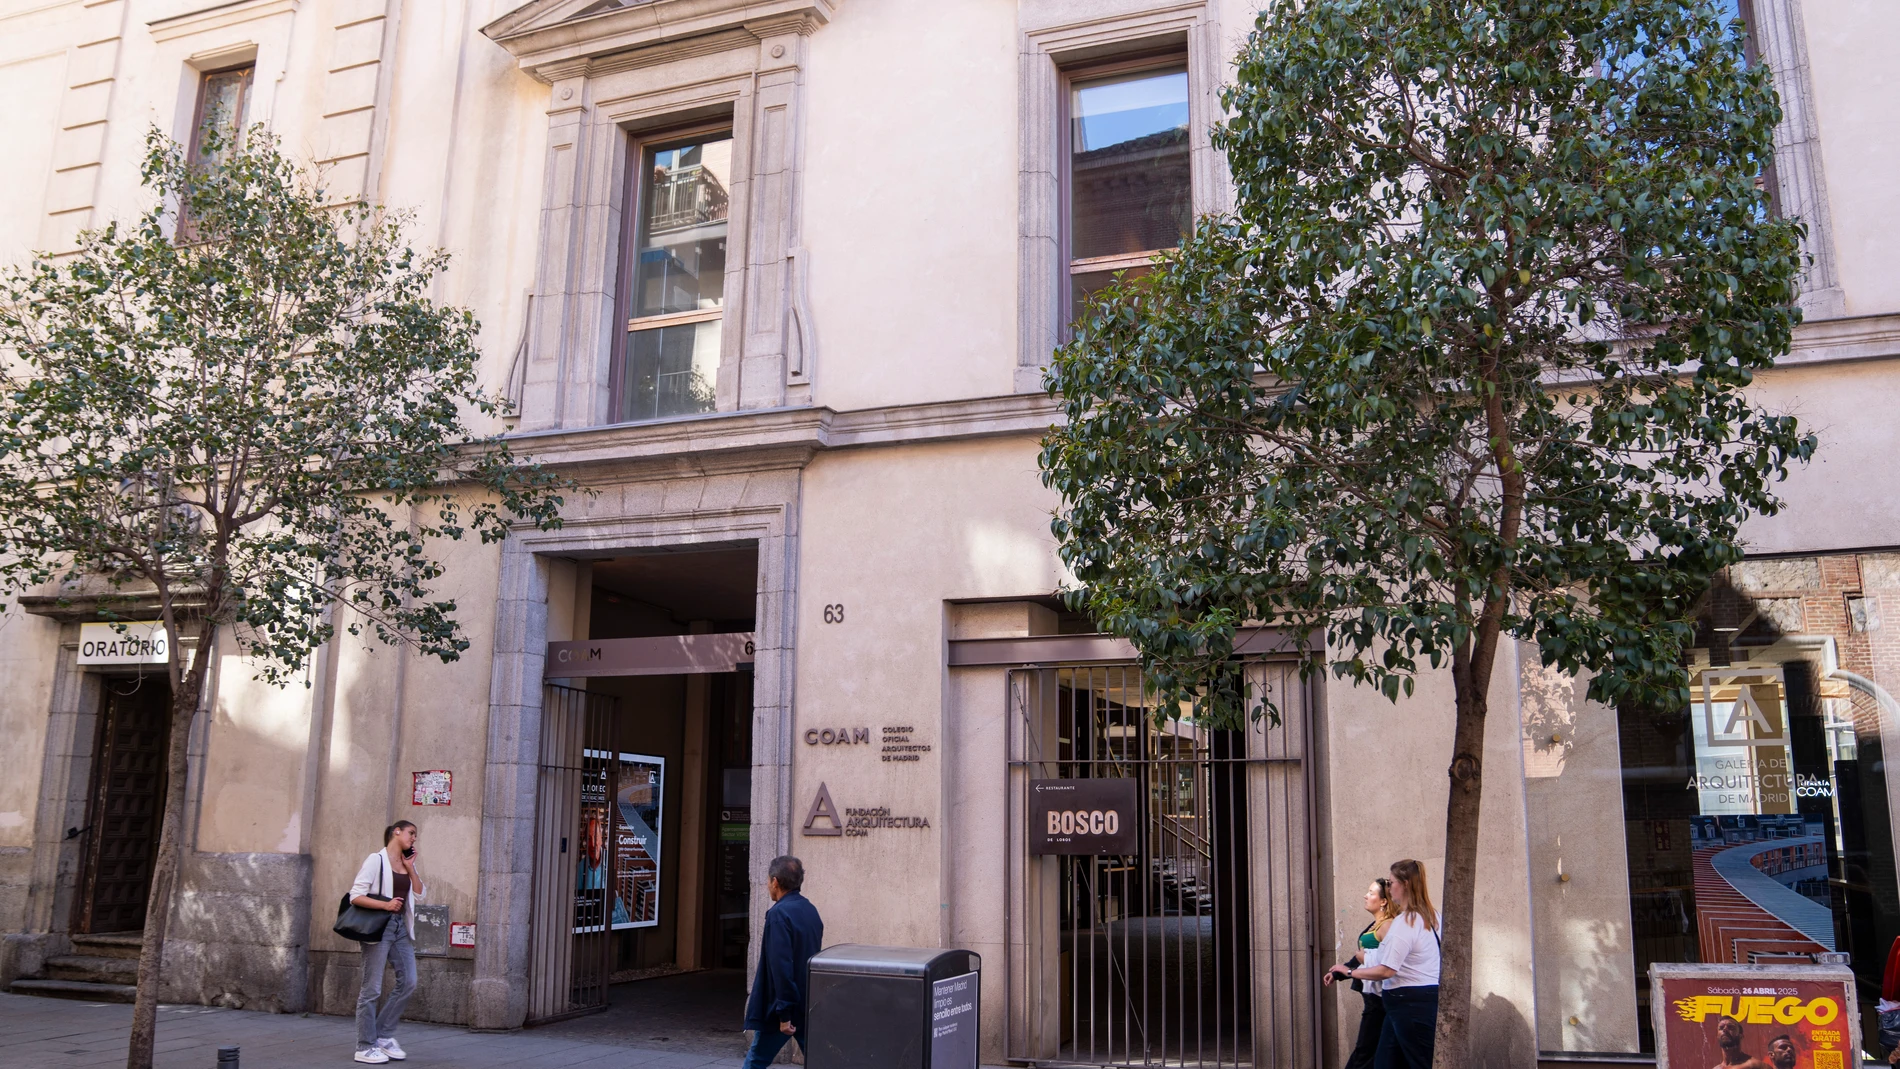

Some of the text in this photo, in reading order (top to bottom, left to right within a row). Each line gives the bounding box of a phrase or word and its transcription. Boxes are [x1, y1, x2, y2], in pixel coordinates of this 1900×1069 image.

[823, 603, 845, 624] 63
[82, 639, 166, 657] ORATORIO
[882, 726, 914, 734] COLEGIO
[804, 727, 870, 745] COAM
[882, 735, 909, 743] OFICIAL
[882, 754, 920, 762] DE MADRID
[1769, 758, 1786, 768] DE
[1686, 773, 1818, 790] ARQUITECTURA
[1796, 786, 1836, 797] COAM
[1719, 793, 1788, 804] DE MADRID
[845, 806, 891, 817] FUNDACIÓN
[845, 816, 931, 829] ARQUITECTURA
[1047, 810, 1119, 835] BOSCO
[845, 828, 869, 837] COAM
[618, 834, 647, 845] Construir
[934, 980, 968, 997] Mantener Madrid
[1707, 986, 1798, 996] Sábado, 26 ABRIL 2025
[1673, 996, 1838, 1026] FUEGO
[1811, 1029, 1840, 1037] ENTRADA
